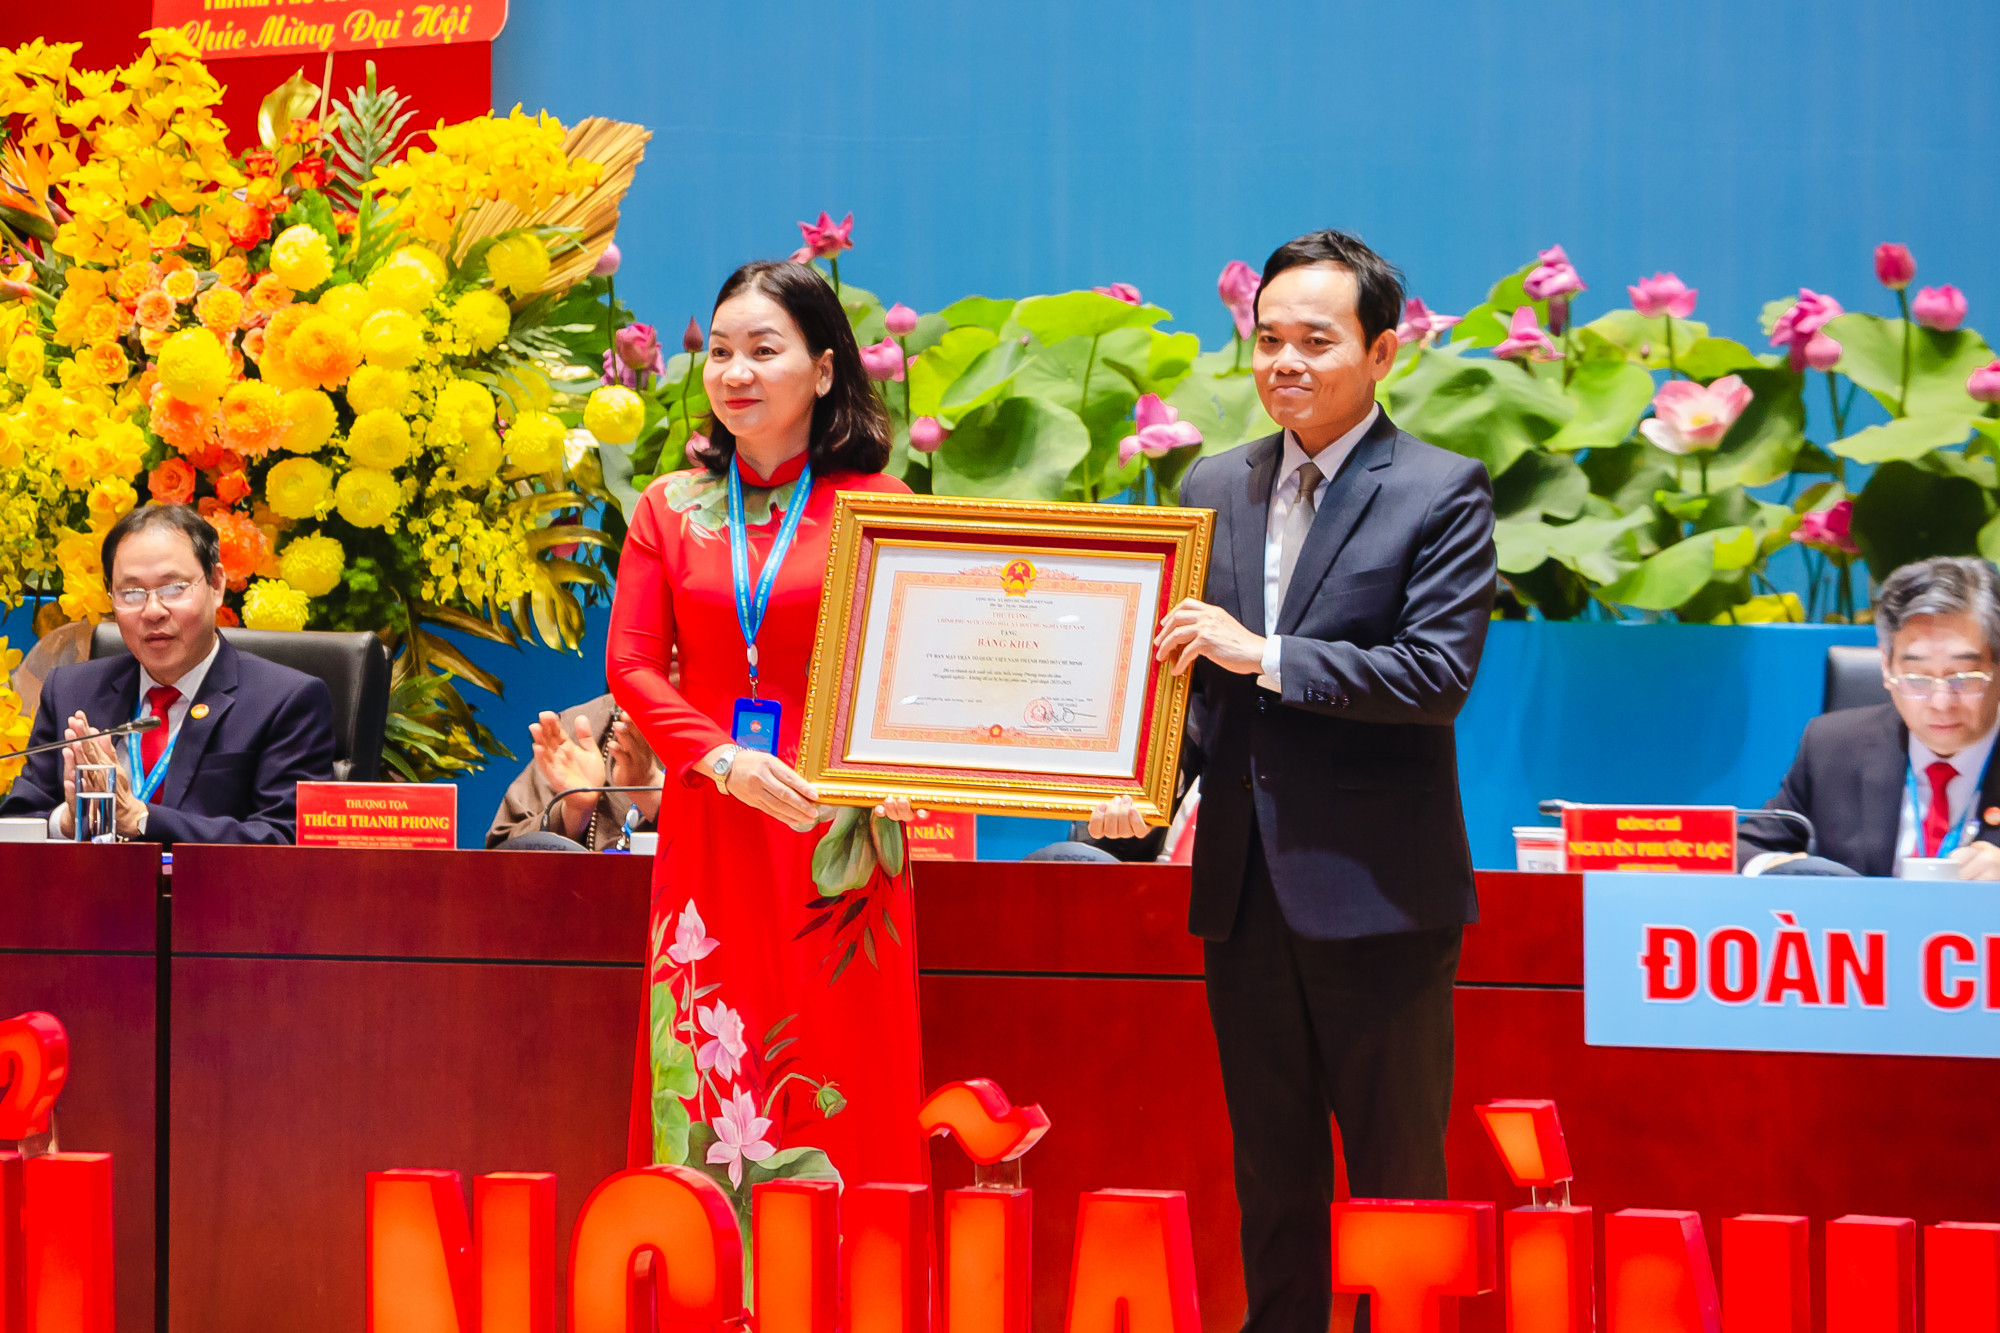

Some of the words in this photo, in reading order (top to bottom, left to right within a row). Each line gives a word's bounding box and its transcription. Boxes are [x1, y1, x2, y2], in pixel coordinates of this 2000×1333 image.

[250, 14, 336, 51] Mừng
[343, 9, 404, 49] Đại
[412, 4, 472, 44] Hội
[345, 799, 387, 810] THƯỢNG
[388, 800, 408, 811] TỌA
[303, 811, 347, 828] THÍCH
[349, 814, 398, 829] THANH
[401, 816, 450, 830] PHONG
[913, 823, 955, 840] NHÂN
[1568, 838, 1635, 857] NGUYỄN
[1637, 839, 1694, 858] PHƯỚC
[1639, 910, 1888, 1010] ĐOÀN
